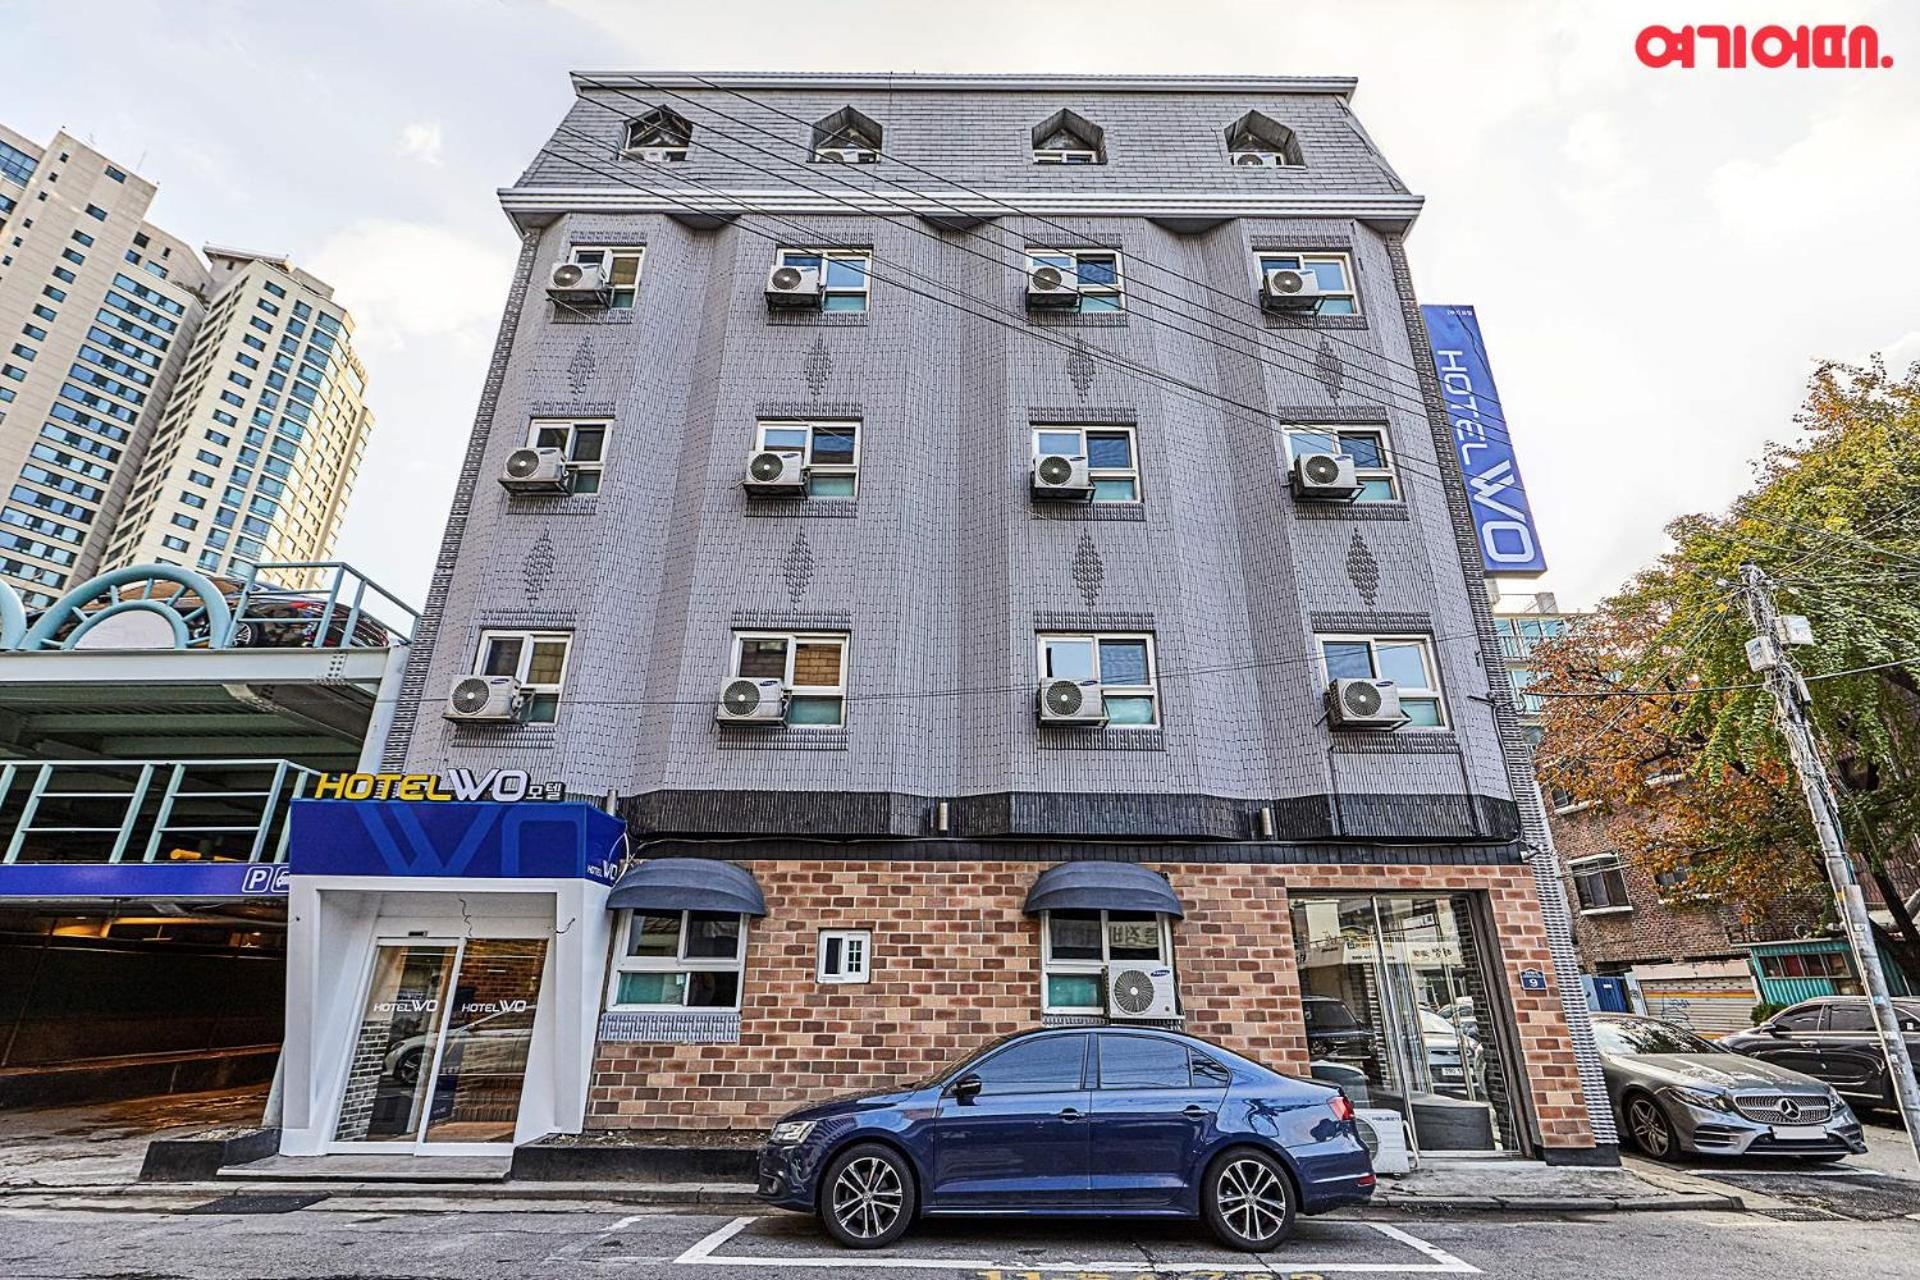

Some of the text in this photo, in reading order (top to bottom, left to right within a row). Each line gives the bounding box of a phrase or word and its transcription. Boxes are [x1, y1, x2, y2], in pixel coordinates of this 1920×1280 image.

[1437, 350, 1488, 466] HOTEL
[1470, 459, 1535, 563] WO
[314, 767, 562, 802] HOTEL WO 모텔
[248, 869, 267, 889] P
[1529, 978, 1538, 988] 9
[373, 1002, 412, 1012] HOTEL
[461, 1002, 500, 1012] HOTEL
